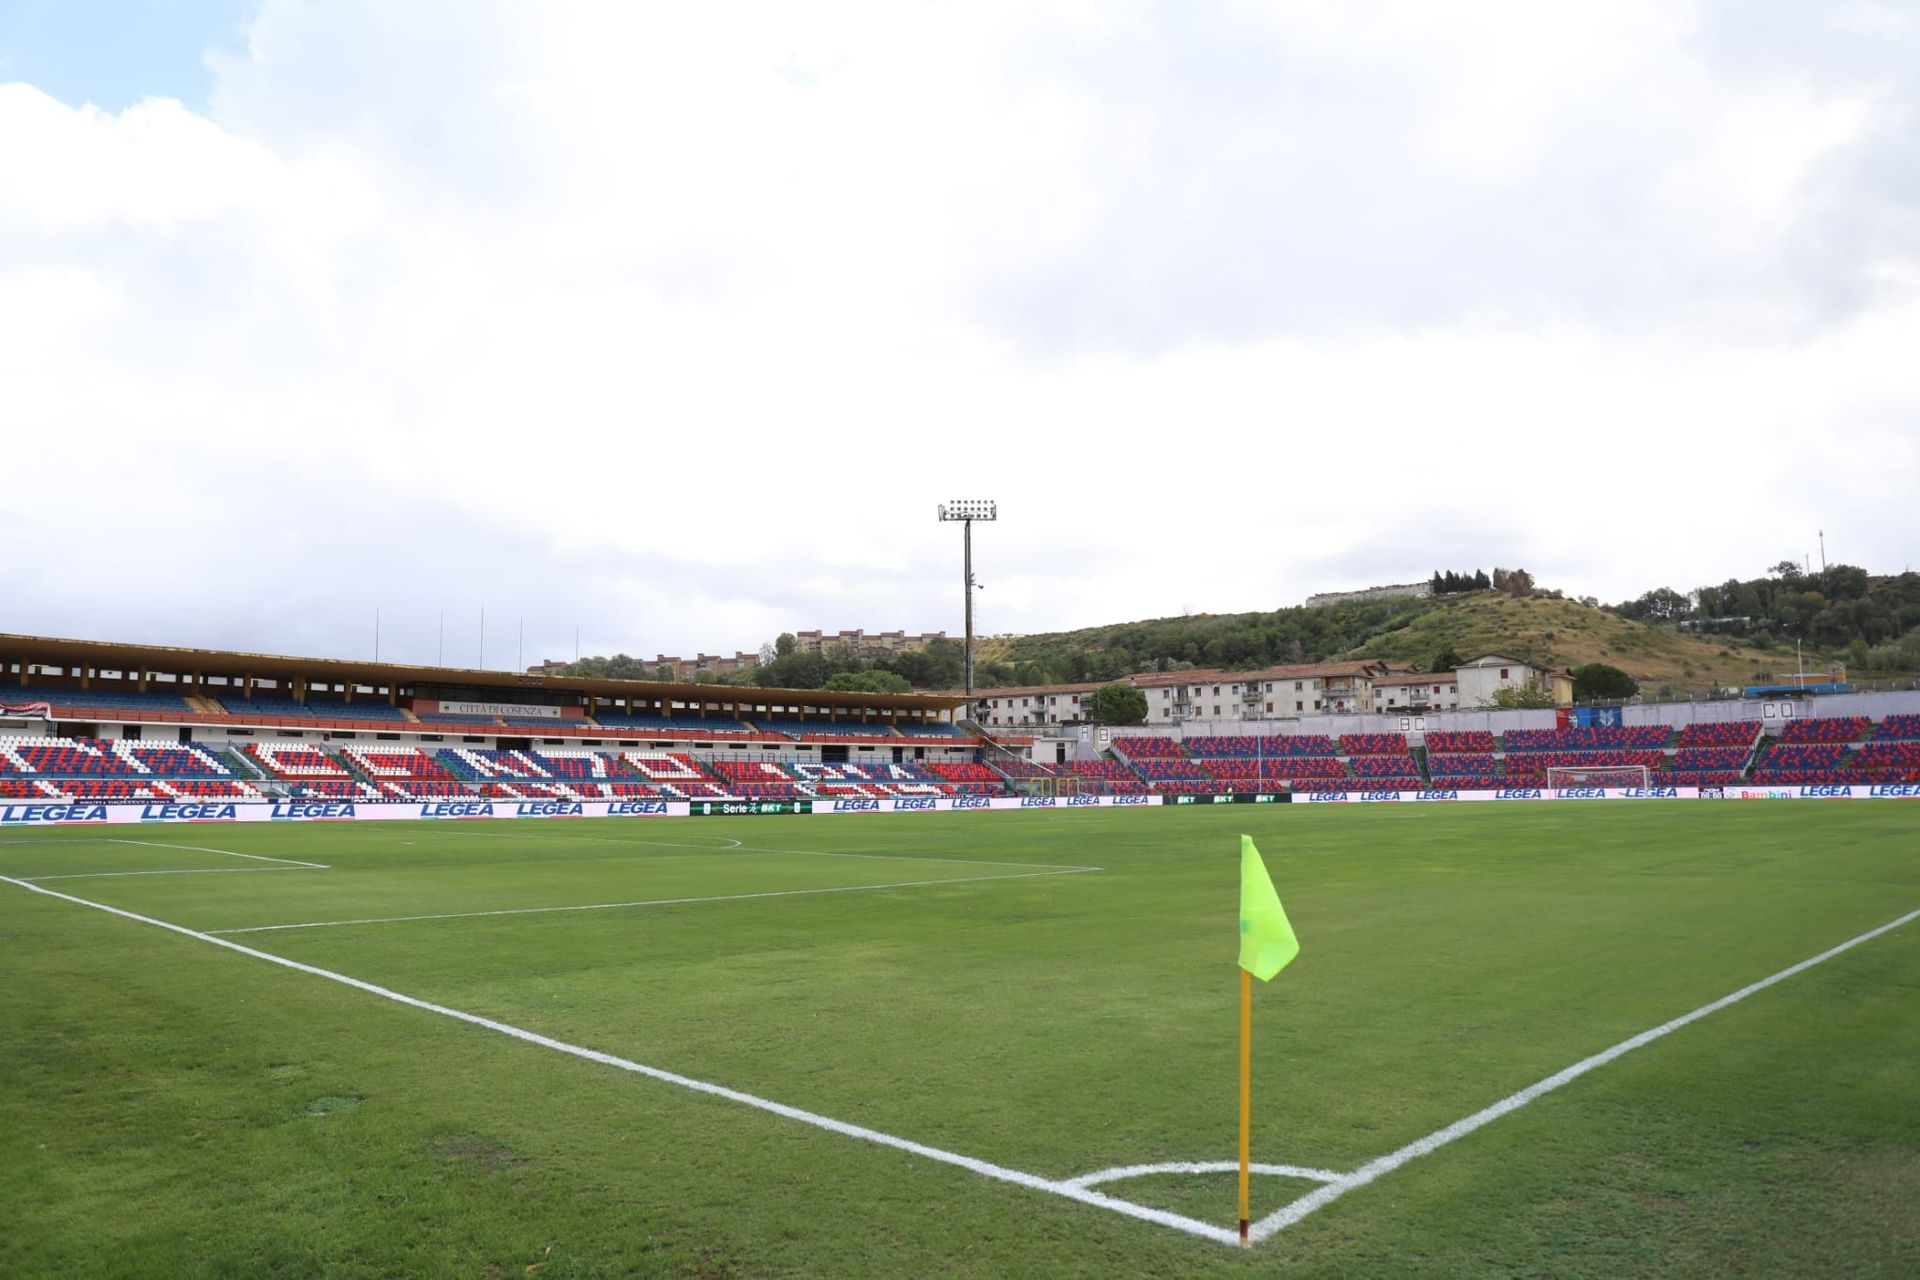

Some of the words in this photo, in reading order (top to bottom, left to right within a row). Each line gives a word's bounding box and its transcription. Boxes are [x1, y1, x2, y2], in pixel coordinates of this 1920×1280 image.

[500, 705, 542, 716] COSENZA
[1361, 791, 1400, 800] LEGEA
[1416, 790, 1458, 800] LEGEA
[1495, 789, 1541, 799] LEGEA
[1557, 788, 1605, 798] LEGEA
[1741, 789, 1792, 799] Bambini
[1800, 785, 1851, 796] LEGEA
[1067, 796, 1100, 805] LEGEA
[1113, 795, 1148, 804] LEGEA
[1177, 796, 1196, 804] BKT
[1214, 795, 1234, 804] BKT
[1256, 795, 1275, 803] BKT
[1309, 792, 1348, 801] LEGEA
[834, 800, 879, 811] LEGEA
[894, 799, 936, 809] LEGEA
[952, 798, 990, 808] LEGEA
[1021, 797, 1056, 807] LEGEA
[1, 805, 107, 821] LEGEA
[141, 805, 236, 819] LEGEA
[271, 804, 355, 818] LEGEA
[420, 803, 493, 817] LEGEA
[517, 803, 582, 815] LEGEA
[608, 802, 667, 814] LEGEA
[723, 804, 747, 813] Serie
[761, 804, 782, 812] BKT
